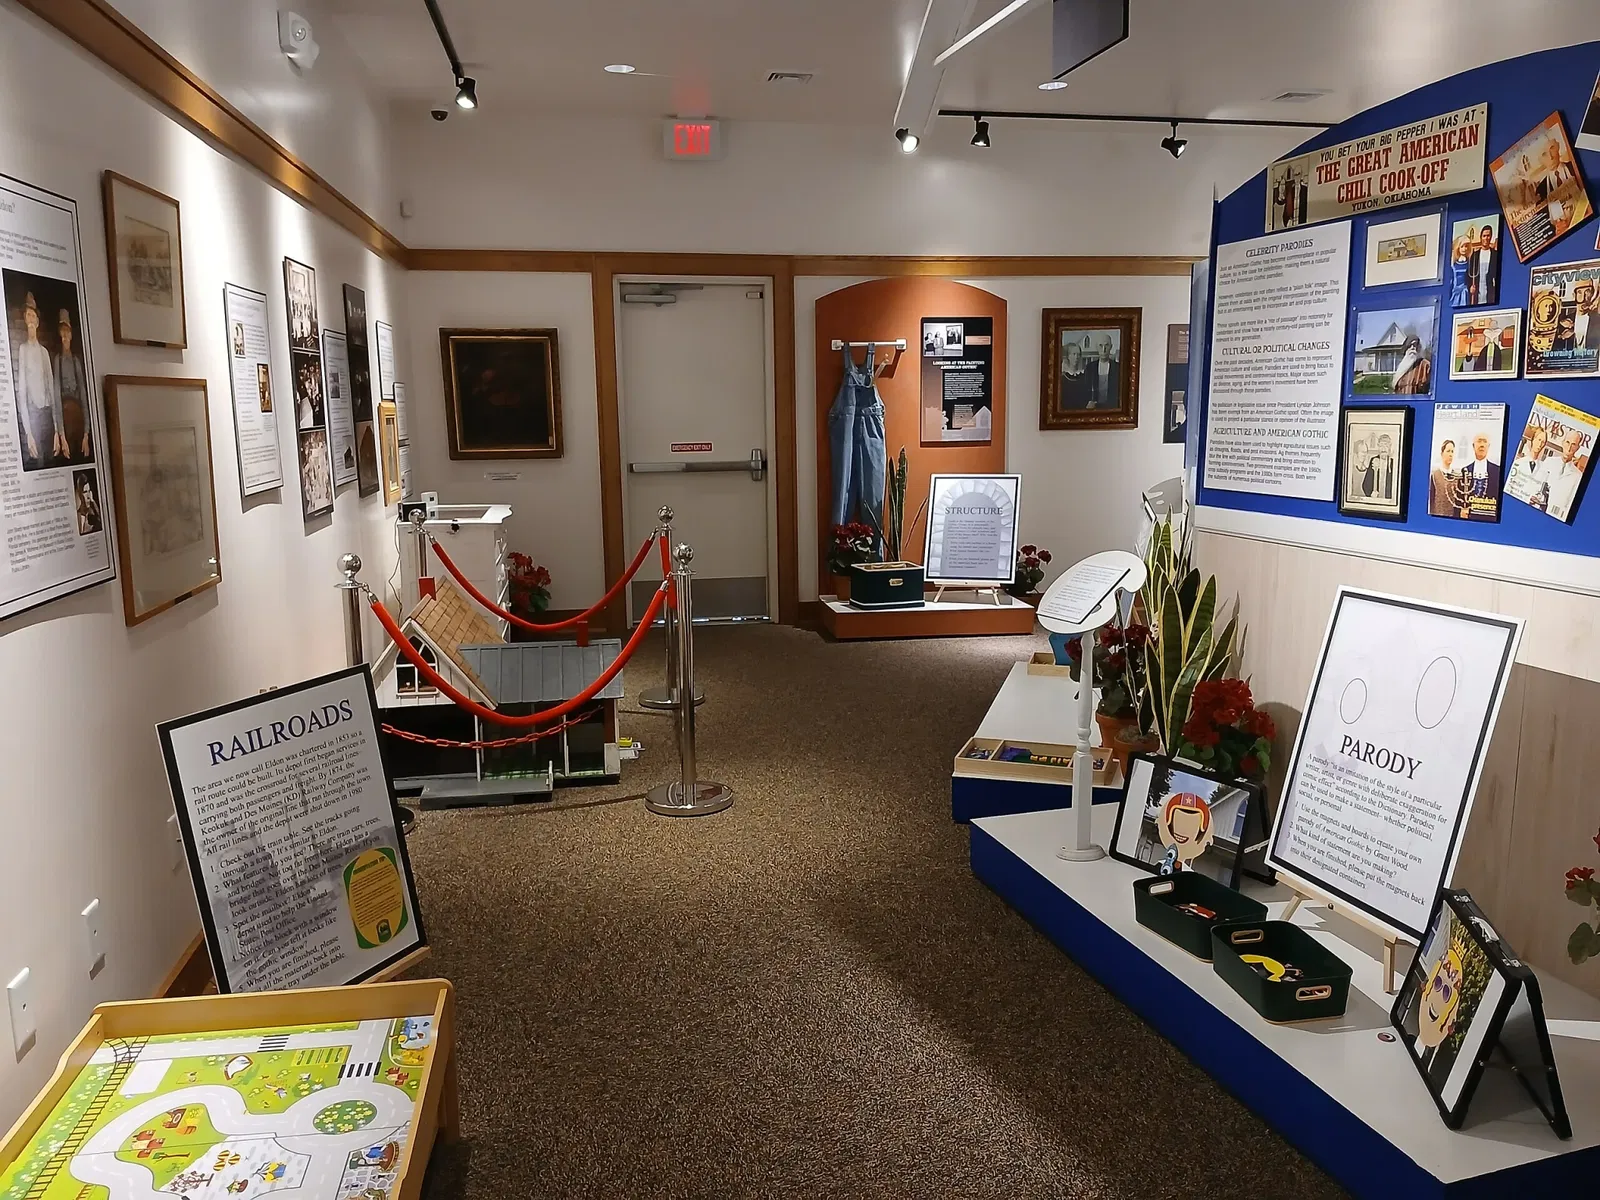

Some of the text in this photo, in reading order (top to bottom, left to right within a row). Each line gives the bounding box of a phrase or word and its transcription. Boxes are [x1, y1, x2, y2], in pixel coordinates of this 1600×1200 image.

[674, 123, 711, 154] EXIT
[1316, 161, 1340, 184] THE
[1348, 148, 1392, 176] GREAT
[1400, 124, 1480, 164] AMERICAN
[1320, 109, 1476, 162] YOU BET YOUR BIG PEPPER I WAS AT
[1338, 158, 1450, 204] CHILI COOK-OFF
[1384, 186, 1432, 204] OKLAHOMA
[1246, 238, 1314, 258] CELEBRITY PARODIES
[1222, 341, 1330, 356] CULTURAL OR POLITICAL CHANGES
[1213, 428, 1329, 439] AGRICULTURE AND AMERICAN GOTHIC
[945, 506, 1003, 515] STRUCTURE
[208, 699, 353, 766] RAILROADS
[1339, 734, 1422, 780] PARODY
[191, 784, 206, 794] The
[207, 779, 222, 789] area
[223, 775, 234, 783] we
[235, 769, 249, 779] now
[251, 762, 263, 773] call
[264, 757, 284, 768] Eldon
[285, 753, 297, 761] was
[298, 740, 327, 756] chartered
[335, 733, 349, 743] 1853
[194, 793, 206, 805] rail
[207, 788, 226, 800] route
[226, 779, 246, 793] could
[246, 777, 256, 785] be
[284, 760, 302, 772] depot
[303, 755, 316, 765] first
[316, 749, 335, 760] began
[196, 801, 214, 814] 1870
[215, 796, 229, 808] and
[229, 792, 244, 802] was
[244, 787, 256, 797] the
[256, 774, 287, 792] crossroad
[287, 772, 298, 780] for
[298, 762, 320, 777] several
[321, 754, 344, 768] railroad
[1311, 756, 1329, 768] parody
[1369, 776, 1376, 784] of
[1376, 779, 1385, 788] the
[1386, 784, 1400, 794] style
[1400, 789, 1408, 797] of
[1412, 795, 1441, 810] particular
[198, 809, 229, 825] carrying
[228, 801, 245, 813] both
[245, 789, 281, 809] passengers
[281, 782, 293, 793] and
[317, 771, 328, 779] By
[345, 760, 354, 769] the
[200, 817, 229, 835] Keokuk
[229, 812, 243, 824] and
[243, 808, 257, 818] Des
[257, 799, 283, 813] Moines
[299, 782, 327, 796] Railway
[327, 771, 355, 786] Company
[356, 766, 367, 774] was
[1309, 781, 1316, 790] be
[1316, 787, 1328, 796] used
[1328, 790, 1334, 798] to
[1334, 795, 1349, 804] make
[1383, 814, 1406, 829] whether
[1405, 825, 1432, 843] political,
[219, 853, 242, 868] Check
[243, 848, 254, 858] out
[255, 844, 266, 853] the
[266, 838, 282, 848] train
[301, 825, 313, 834] See
[314, 819, 324, 829] the
[324, 812, 342, 824] tracks
[343, 805, 360, 818] going
[1294, 823, 1397, 879] What kind of statement are you making?
[1292, 833, 1306, 846] When
[1306, 843, 1316, 851] you
[1347, 862, 1365, 876] please
[1365, 872, 1375, 880] put
[1375, 875, 1385, 885] the
[1385, 882, 1410, 898] magnets
[1410, 891, 1425, 905] back
[246, 973, 266, 988] When
[267, 966, 280, 979] you
[281, 960, 292, 970] are
[319, 935, 338, 951] please
